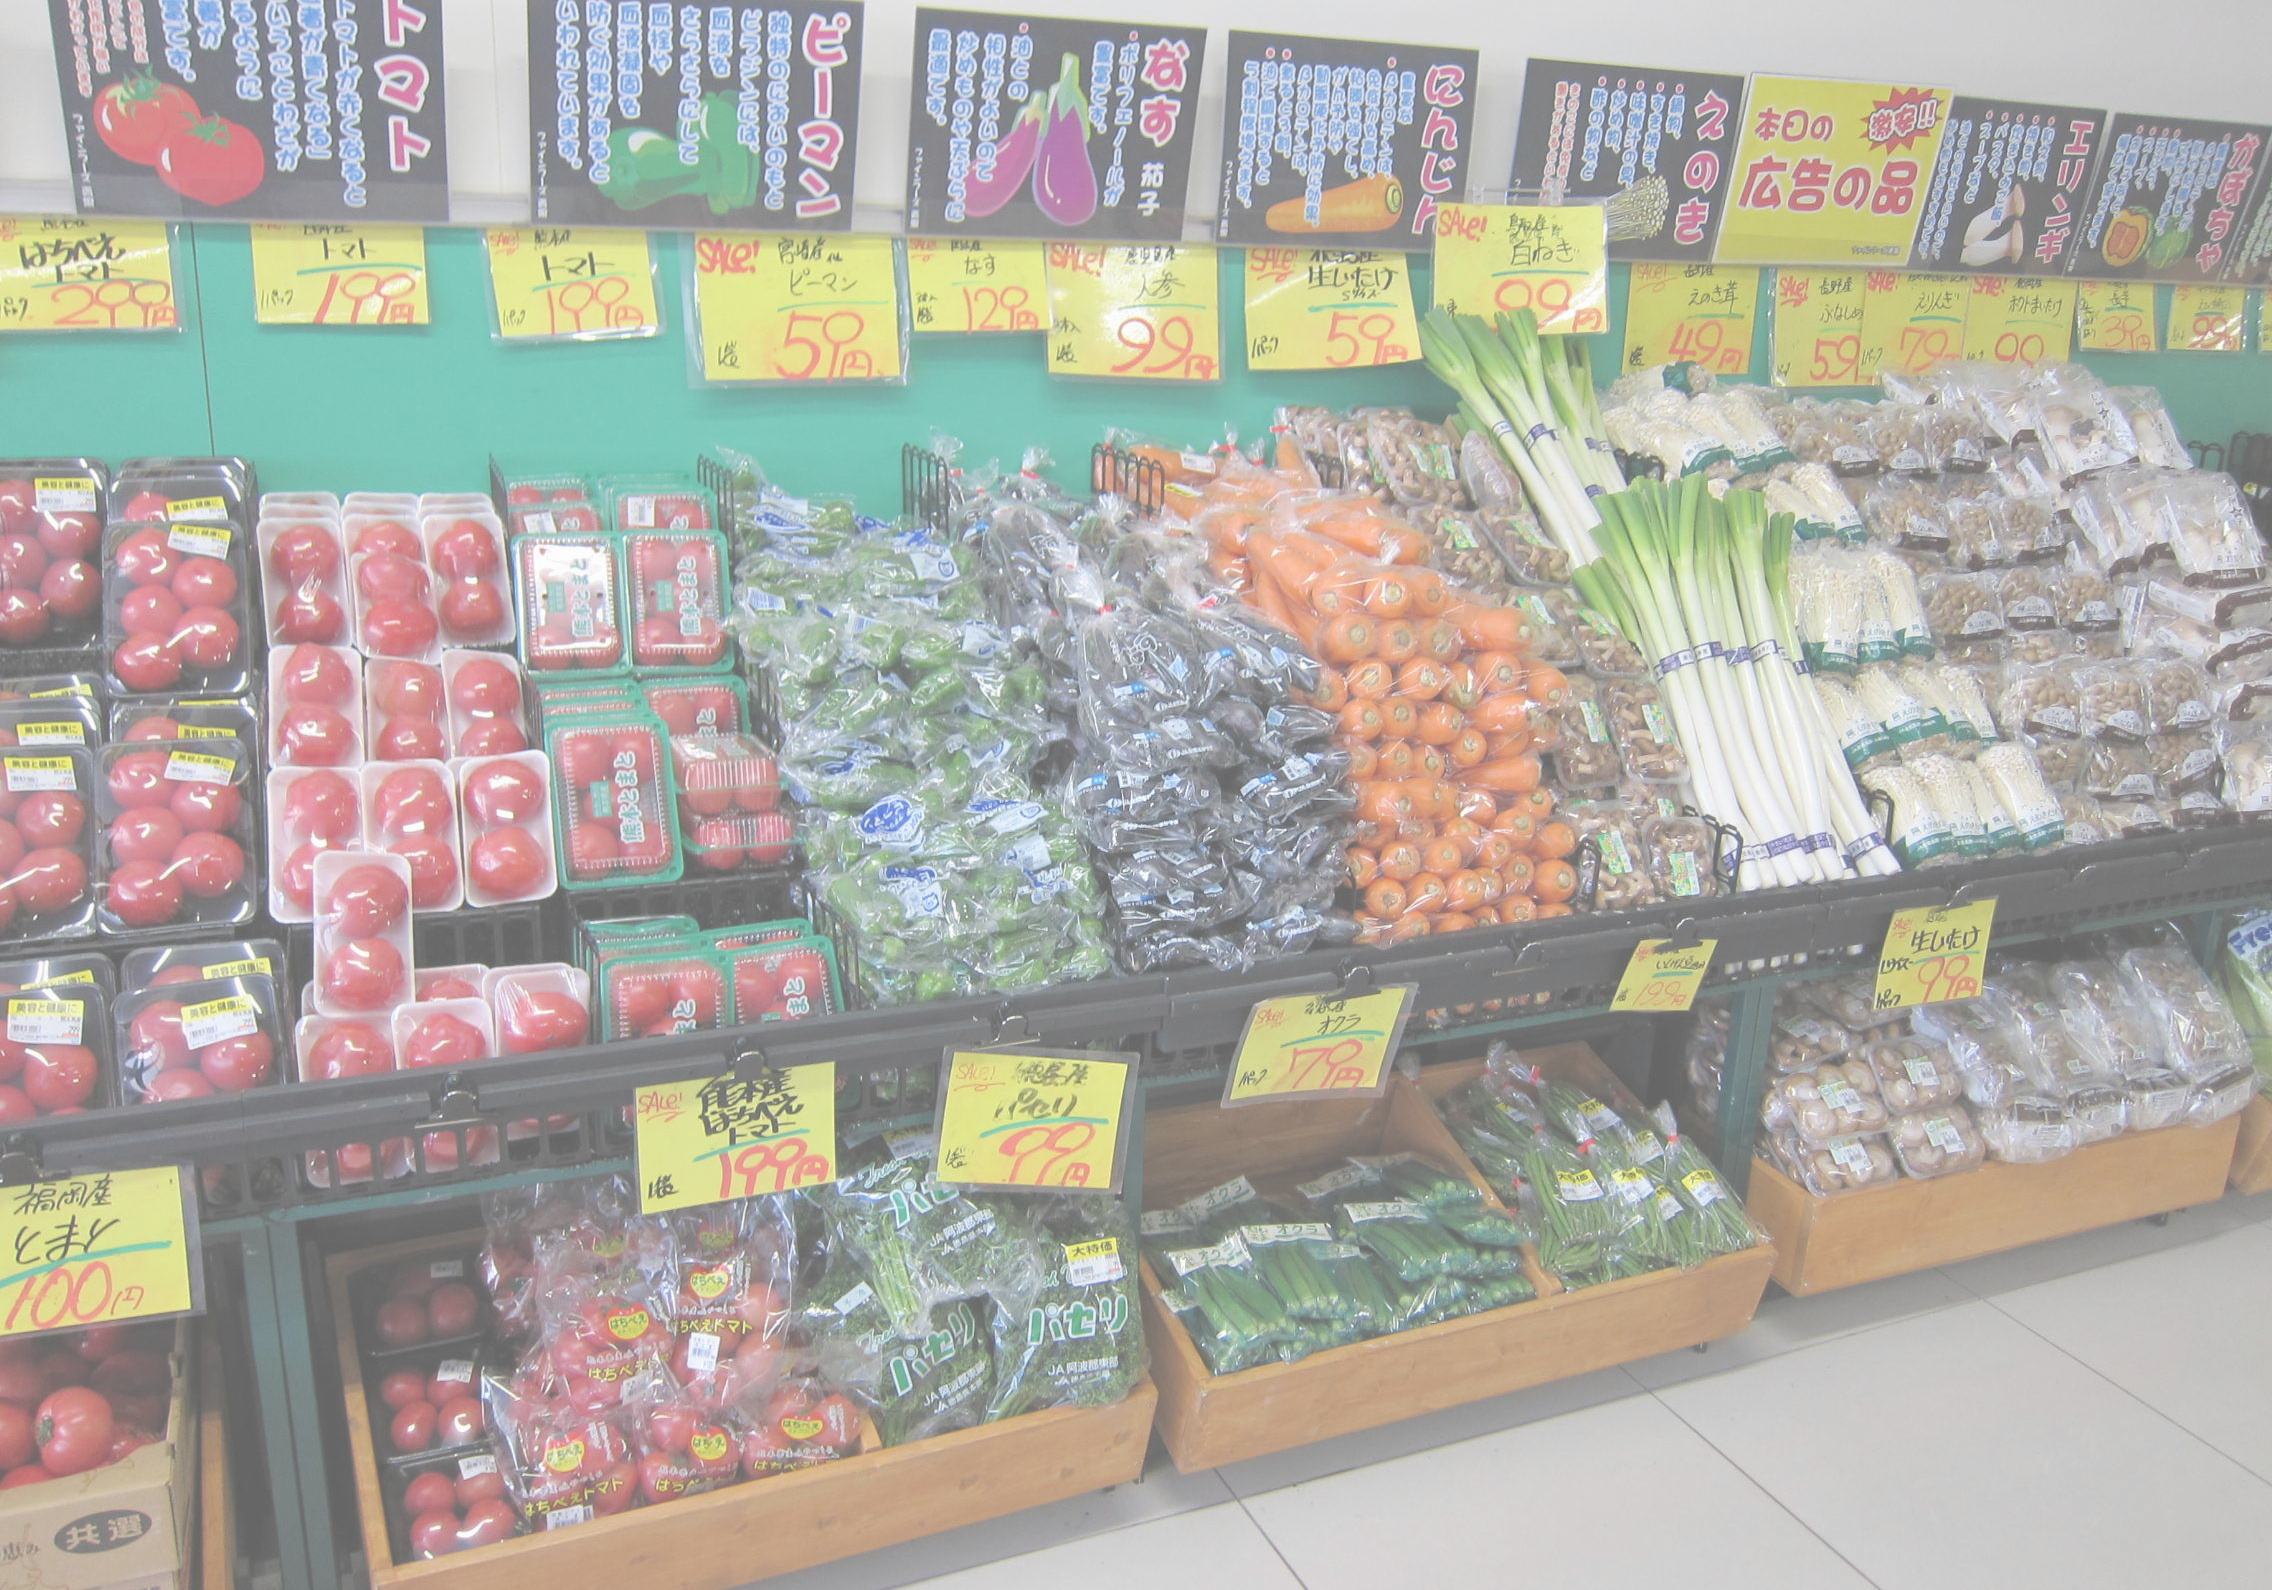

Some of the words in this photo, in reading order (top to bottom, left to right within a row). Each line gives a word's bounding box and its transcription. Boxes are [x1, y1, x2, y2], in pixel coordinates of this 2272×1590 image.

[374, 0, 430, 171] トマト
[1008, 35, 1033, 102] 油との
[333, 0, 366, 207] トマトが赤くなると
[764, 11, 792, 210] 独特のにおいのもと
[976, 32, 1007, 182] 相性がよいので
[1141, 37, 1190, 148] なす
[796, 12, 850, 218] ピーマン
[1103, 42, 1140, 207] ポリフェノールが
[1754, 107, 1834, 143] 本日の
[1412, 64, 1464, 234] にんじん
[1674, 89, 1729, 245] えのき
[1138, 162, 1164, 216] 茄子
[1737, 154, 1919, 216] 広告の品
[2034, 120, 2095, 264] エリンギ
[19, 232, 126, 269] はちべえ
[322, 238, 377, 260] トマト
[541, 251, 615, 281] トマト
[965, 255, 996, 276] なす
[1510, 238, 1579, 266] 白ねぎ
[55, 258, 125, 283] トマト
[790, 269, 858, 296] ピーマン
[1134, 271, 1186, 301] 人参
[1308, 265, 1398, 290] 生しいたけ
[1914, 292, 1960, 314] えりんぎ
[613, 750, 647, 845] 熊本とまと
[1911, 926, 1981, 954] 生しいたけ
[1317, 1014, 1361, 1034] オクラ
[993, 1087, 1078, 1122] パセリ
[729, 1118, 797, 1145] トマト
[14, 1174, 113, 1215] 福岡産
[15, 1215, 121, 1264] とまと
[1072, 1240, 1114, 1257] 大特価
[1278, 1224, 1319, 1238] オクラ
[1027, 1293, 1130, 1348] パセリ
[890, 1301, 976, 1397] パセリ
[66, 1513, 143, 1550] 共選
